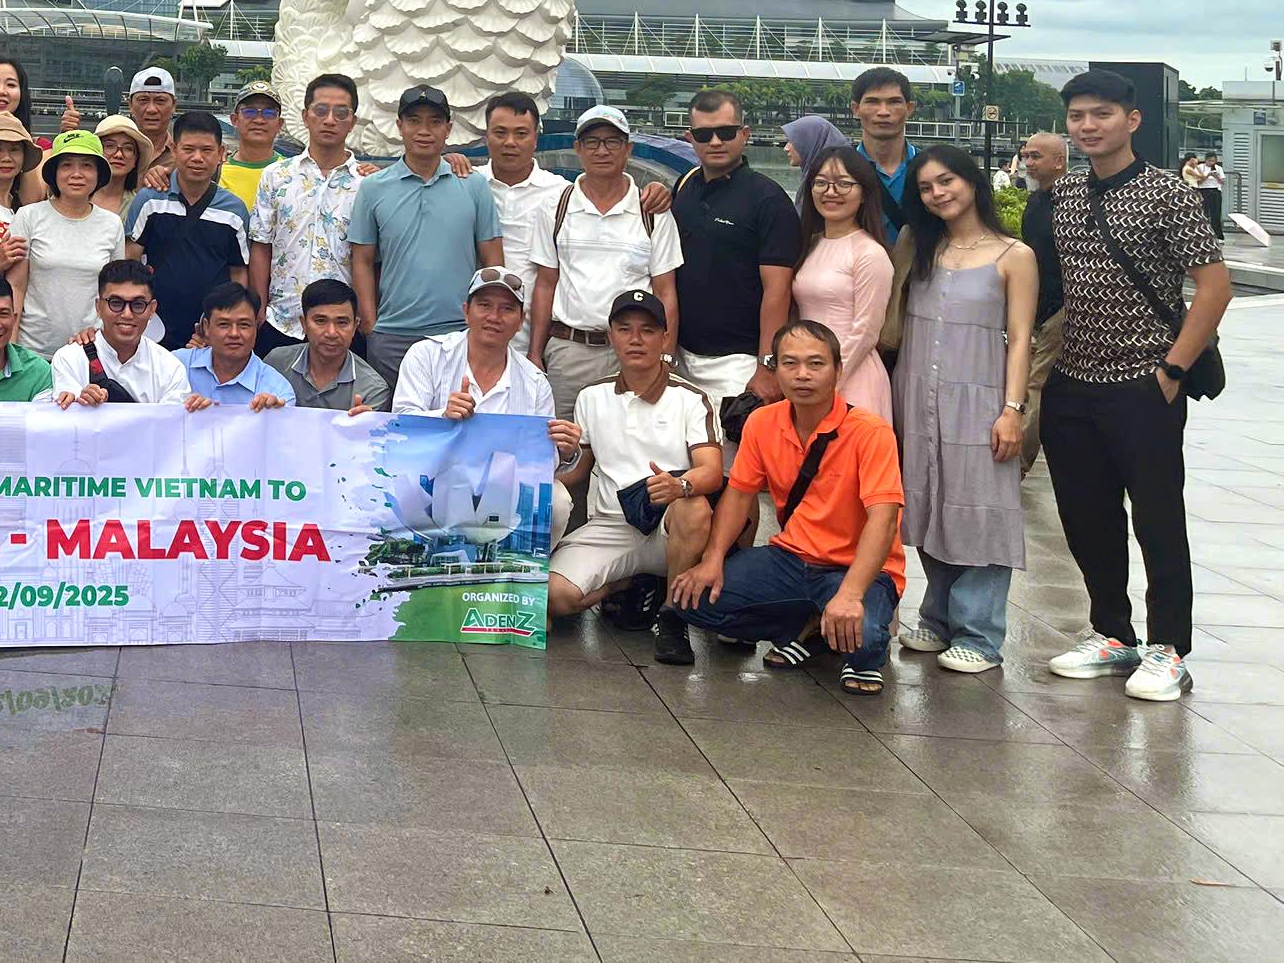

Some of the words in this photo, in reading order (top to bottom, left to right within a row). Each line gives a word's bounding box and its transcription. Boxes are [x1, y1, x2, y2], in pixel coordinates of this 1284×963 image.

[633, 292, 644, 302] C
[134, 477, 263, 500] VIETNAM
[267, 479, 308, 503] TO
[11, 534, 28, 545] -
[46, 519, 331, 563] MALAYSIA
[462, 592, 520, 604] ORGANIZED
[522, 595, 536, 606] BY
